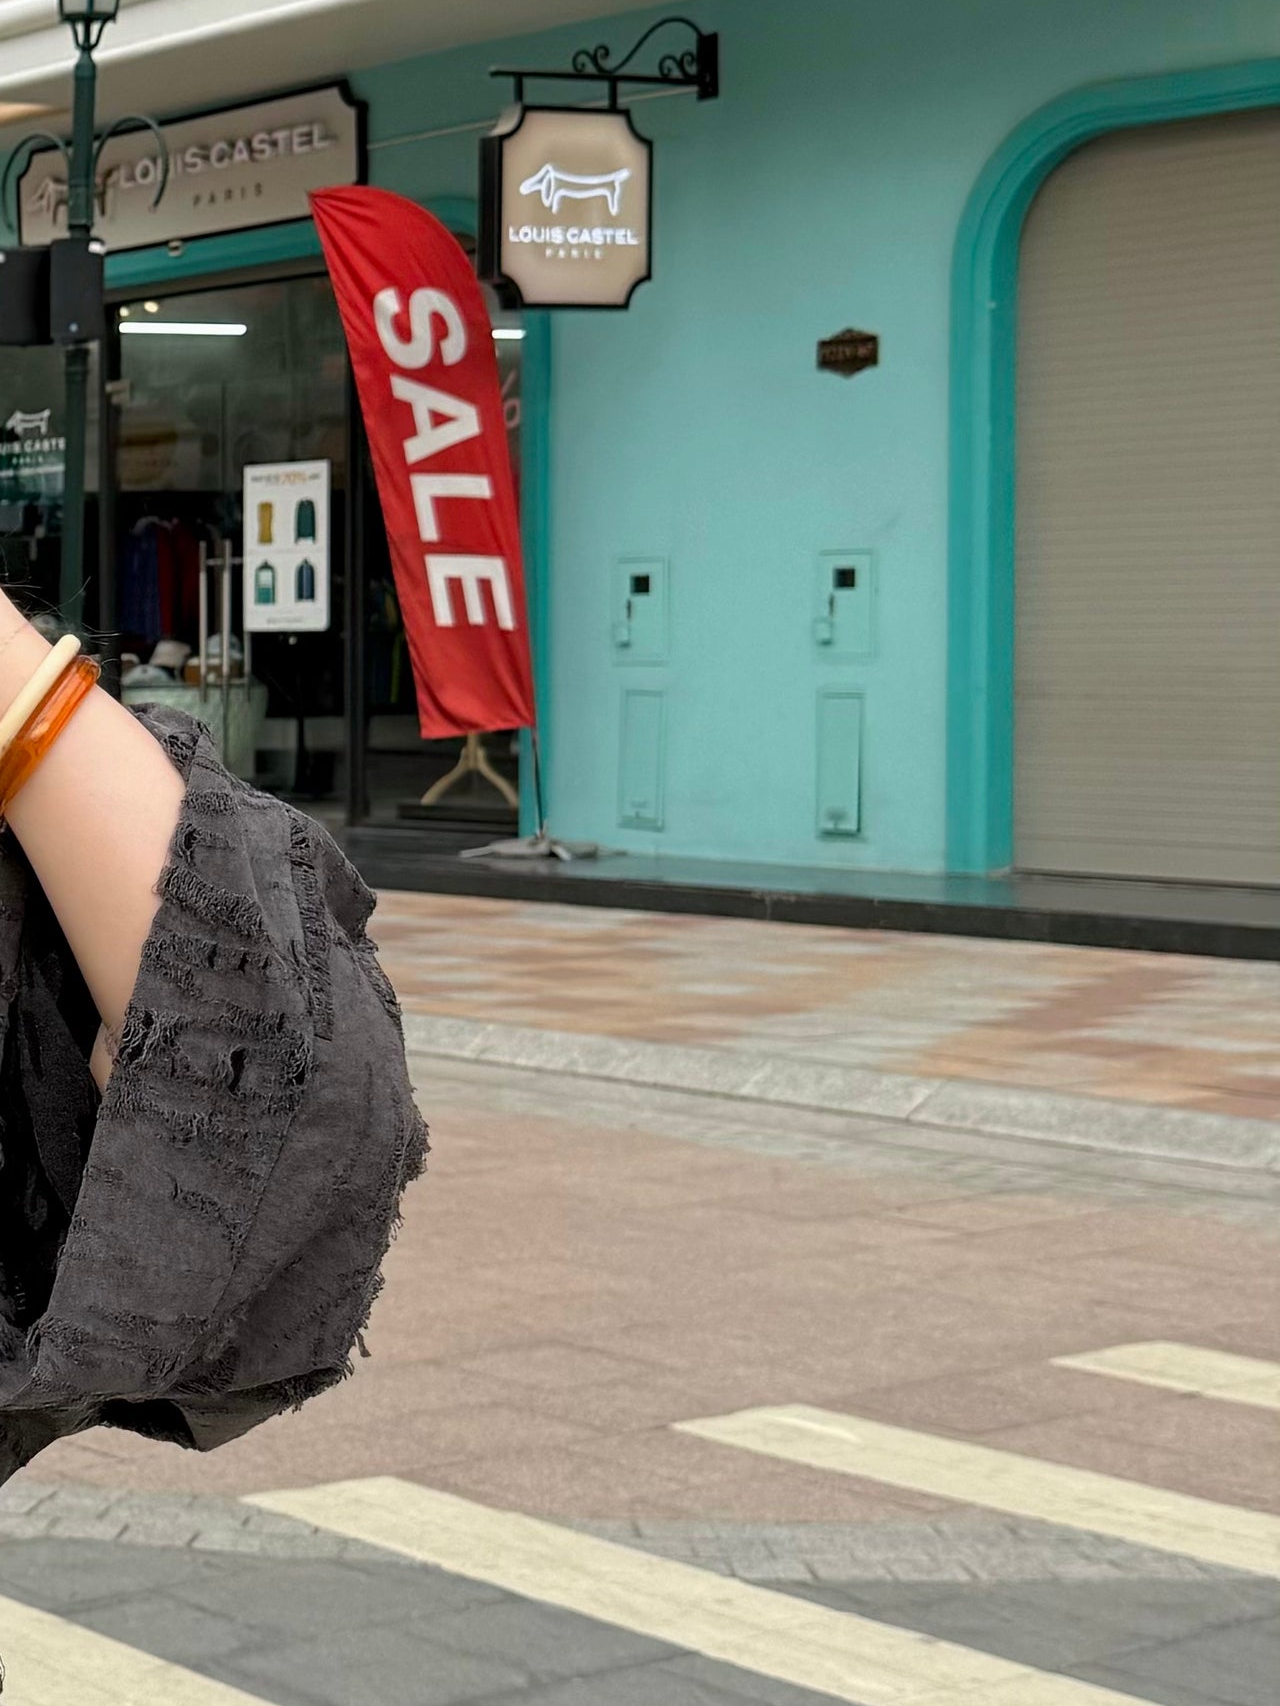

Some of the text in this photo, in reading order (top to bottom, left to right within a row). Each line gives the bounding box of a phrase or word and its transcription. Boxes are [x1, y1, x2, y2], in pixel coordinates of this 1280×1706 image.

[118, 123, 331, 189] LOUIS CASTEL
[192, 182, 265, 207] PARIS
[508, 226, 639, 245] LOUIS CASTEL
[545, 247, 603, 260] PARIS
[373, 287, 516, 631] SALE
